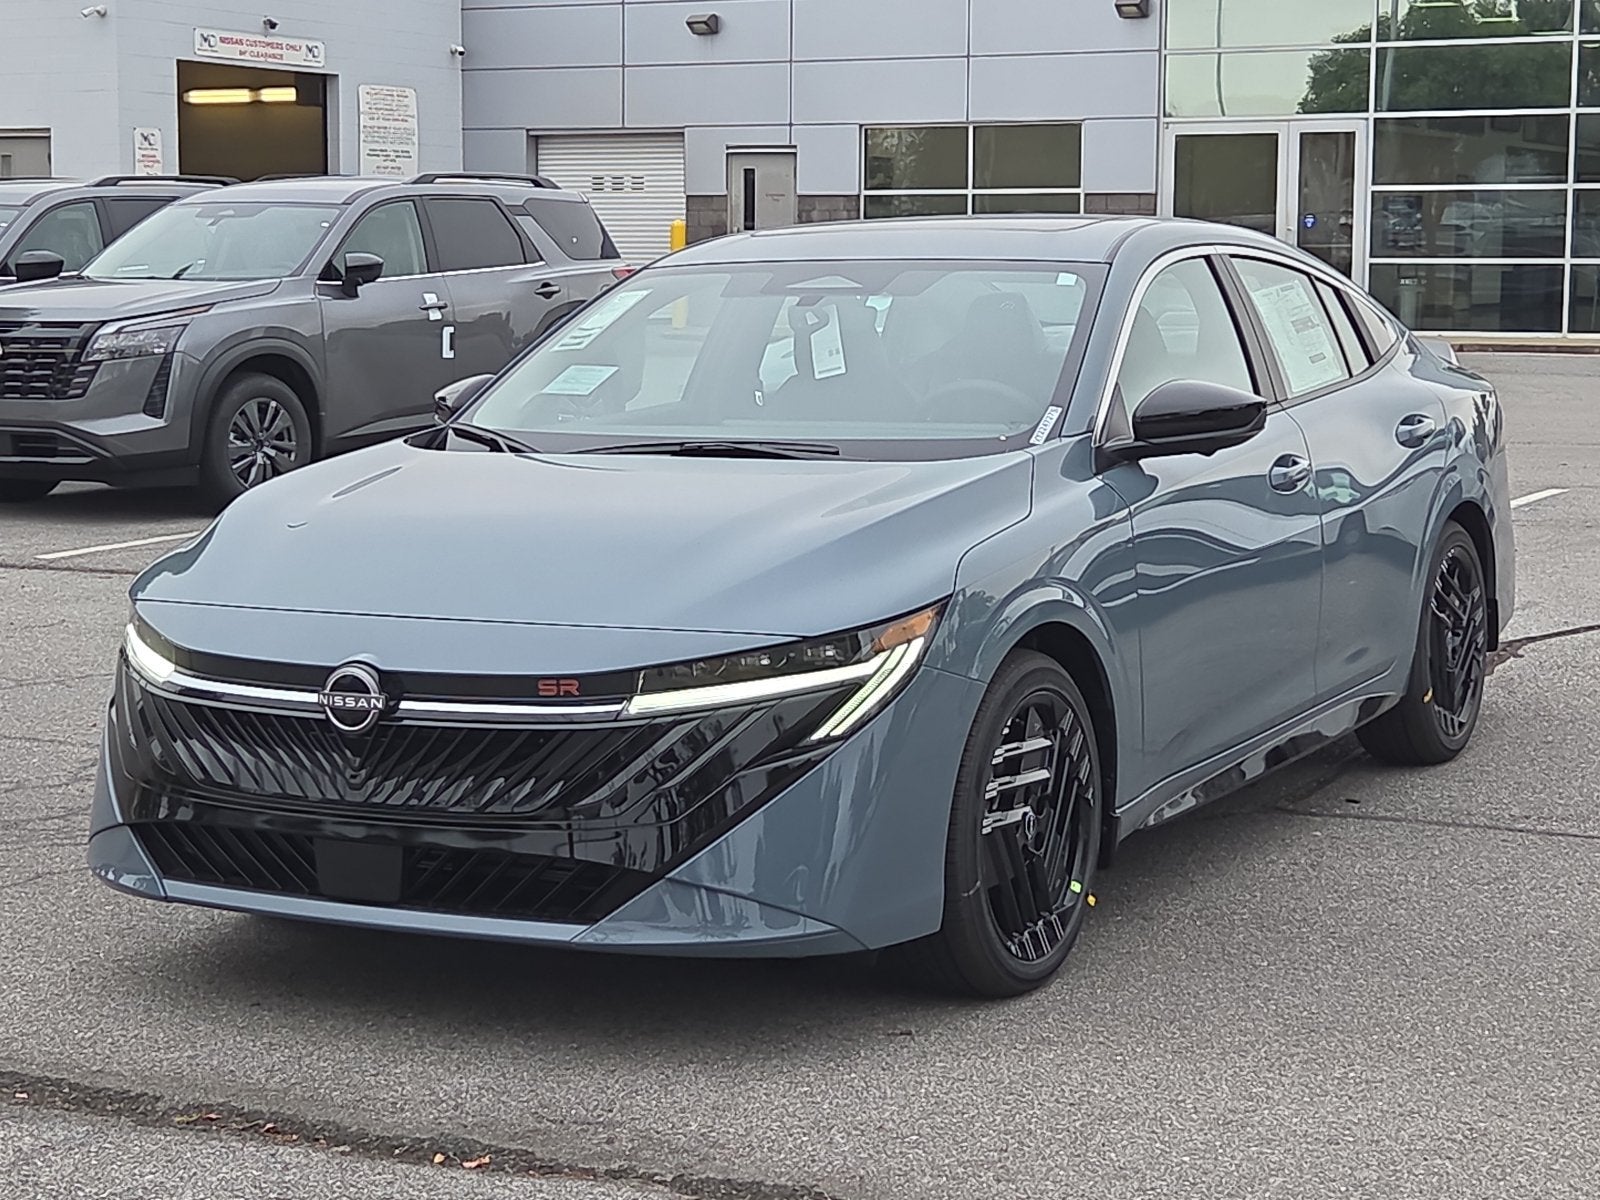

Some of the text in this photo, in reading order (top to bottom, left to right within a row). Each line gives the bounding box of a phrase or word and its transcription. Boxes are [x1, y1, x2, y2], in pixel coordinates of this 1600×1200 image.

[245, 39, 284, 50] CUSTOMERS
[285, 43, 302, 52] ONLY
[249, 50, 284, 60] CLEARANCE
[537, 679, 581, 696] SR
[318, 693, 384, 710] NISSAN
